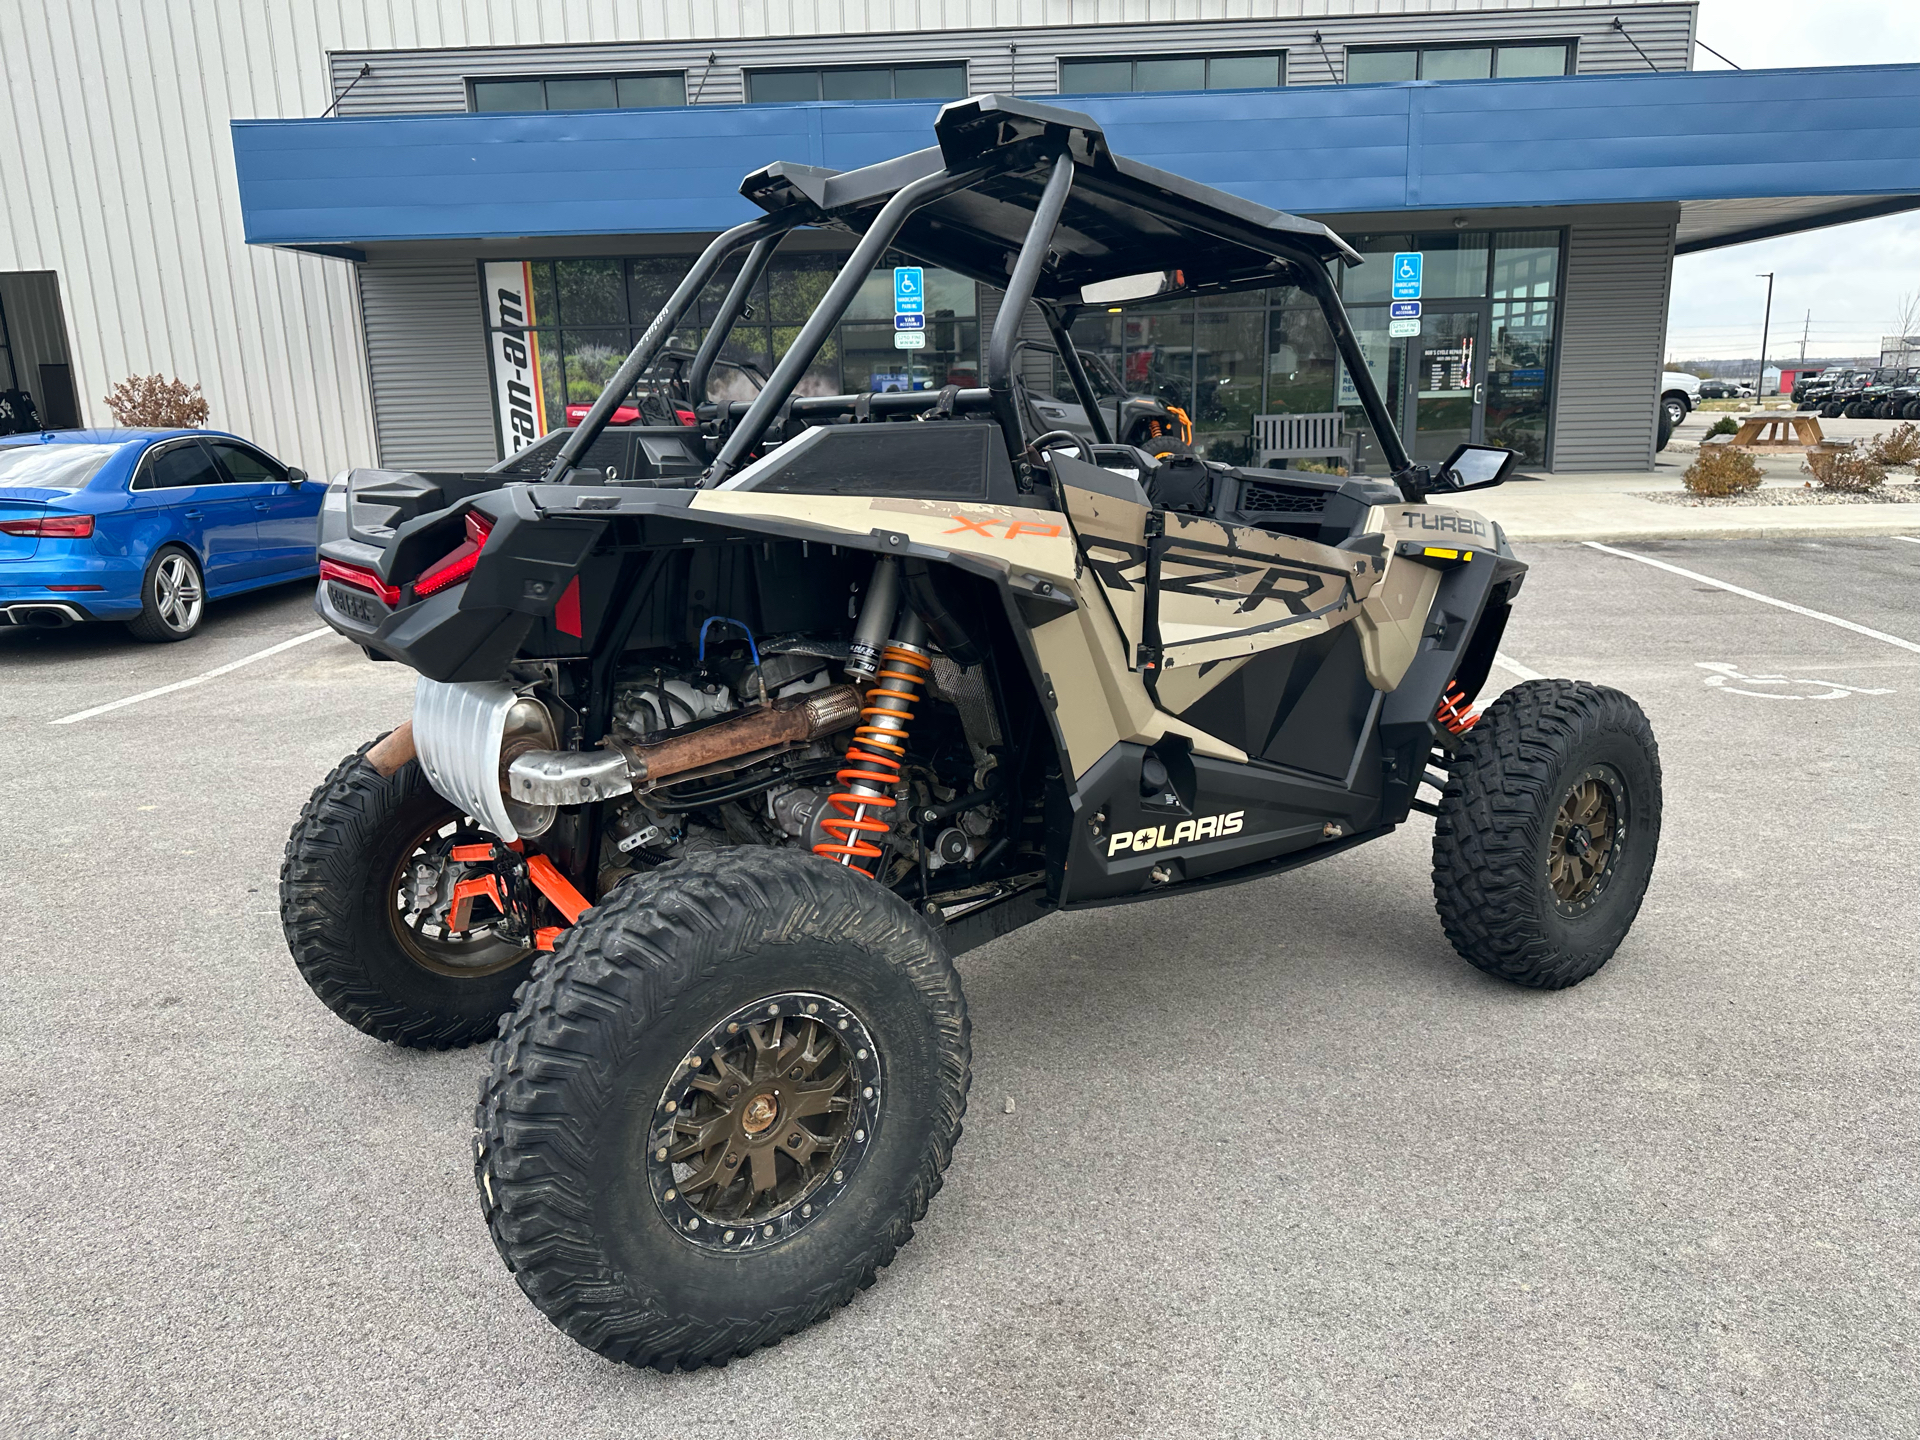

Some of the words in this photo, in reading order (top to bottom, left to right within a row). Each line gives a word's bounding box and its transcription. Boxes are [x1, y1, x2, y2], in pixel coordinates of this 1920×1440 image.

[941, 515, 1063, 540] XP
[1402, 511, 1487, 538] TURBO
[1079, 533, 1322, 621] RZR
[1107, 810, 1245, 858] POLARIS
